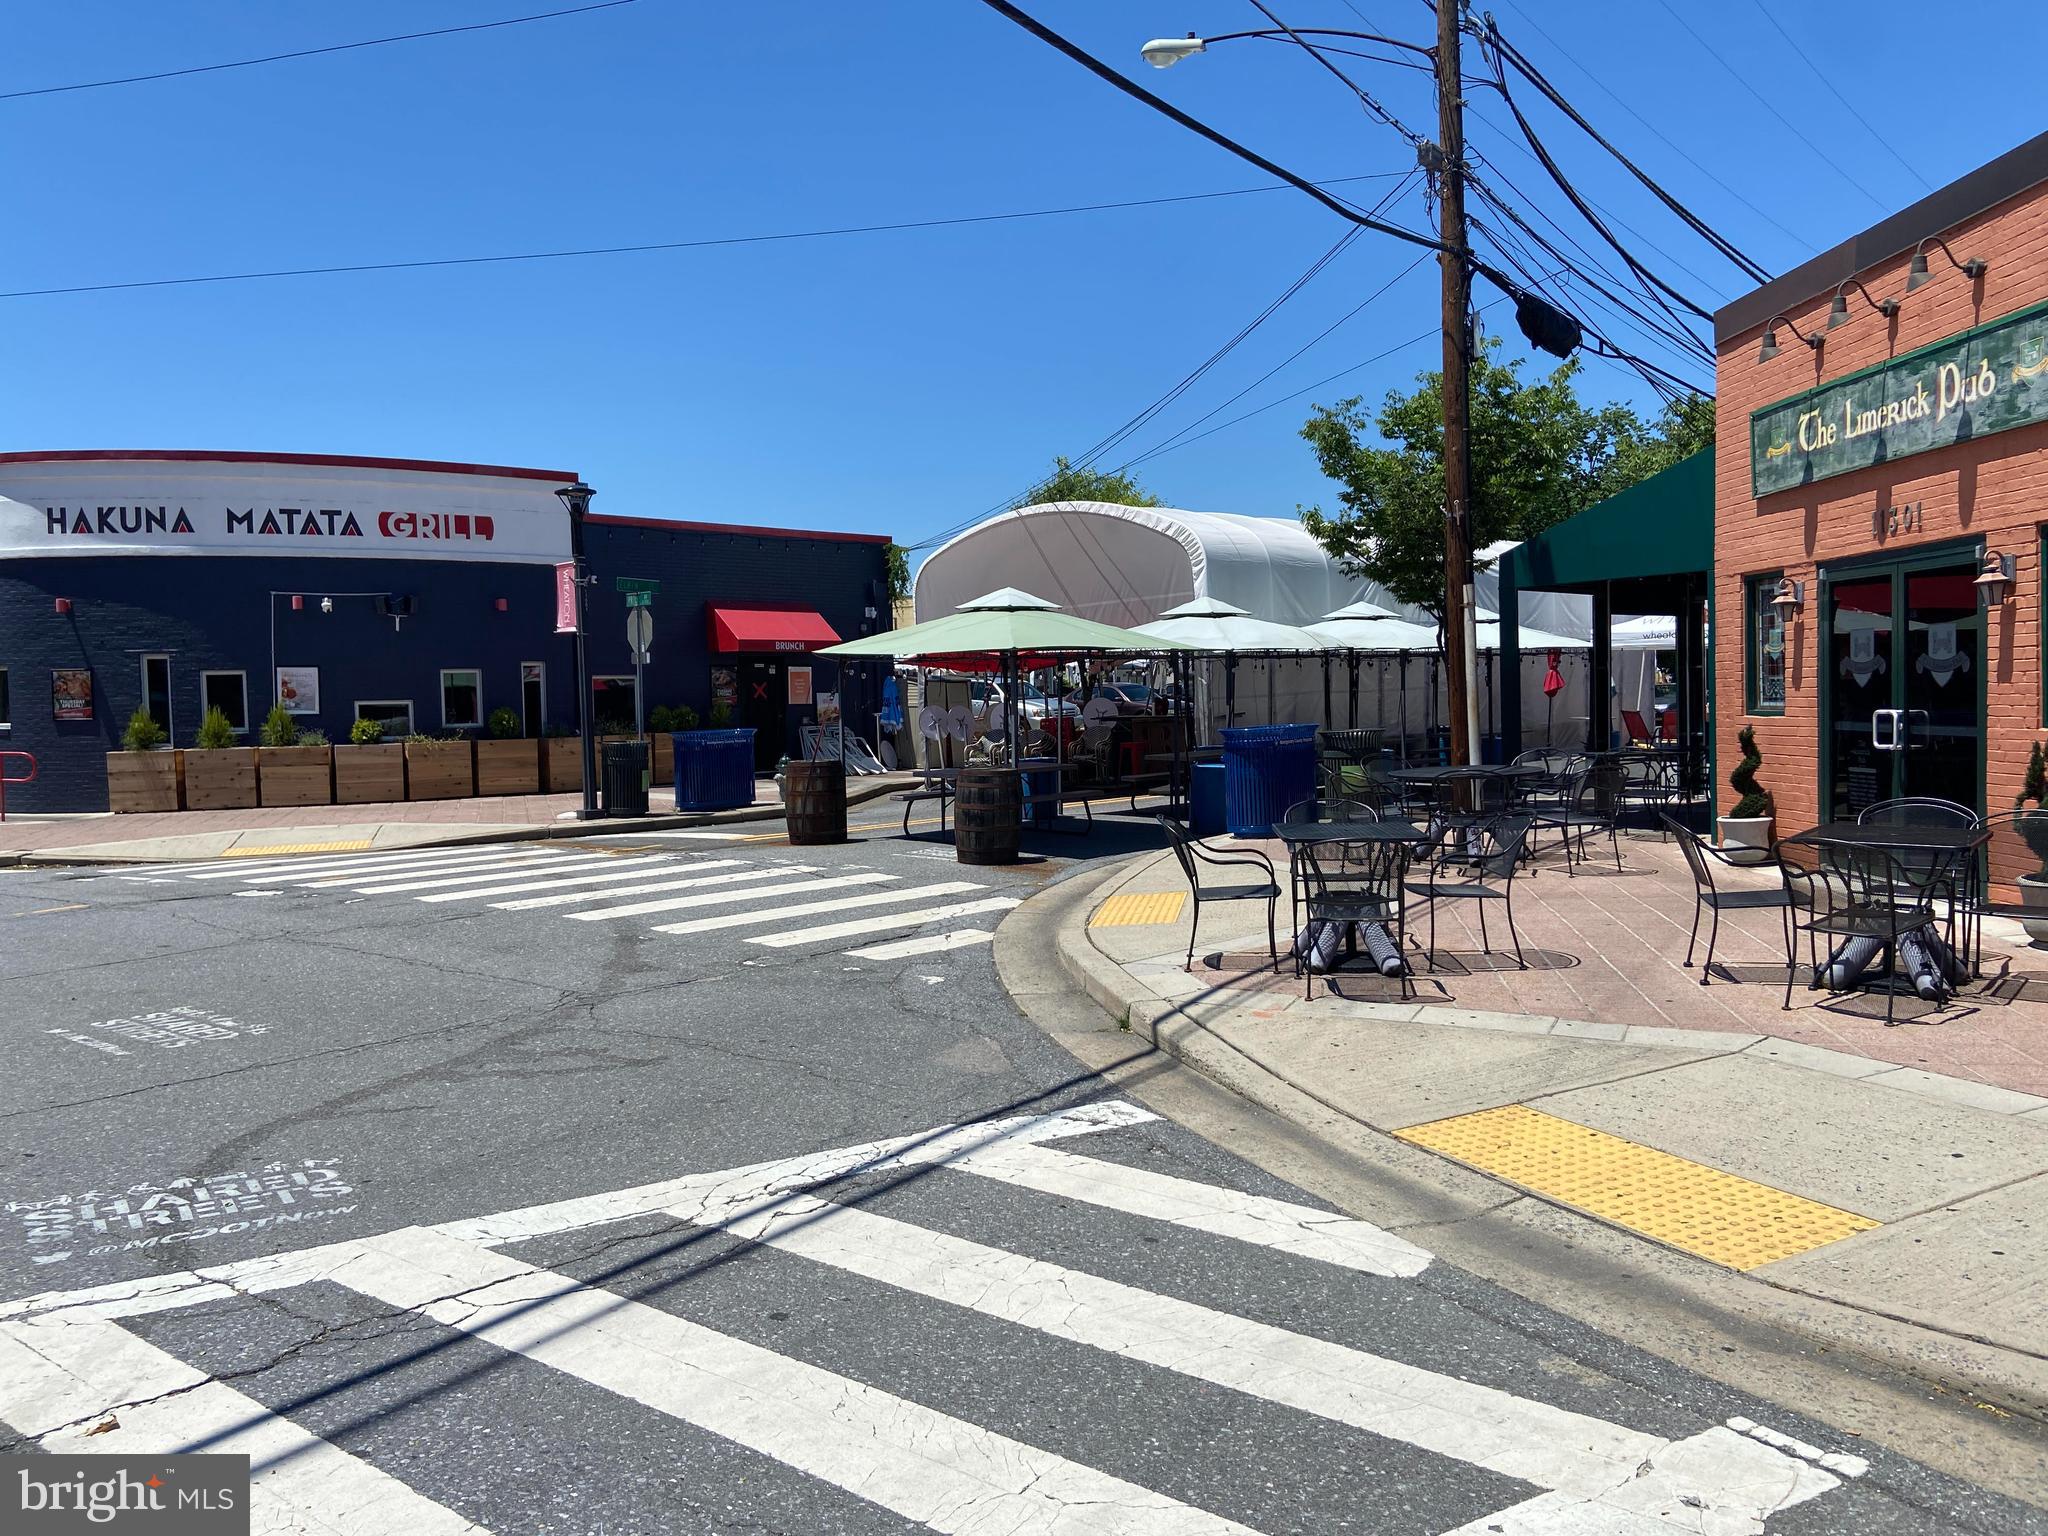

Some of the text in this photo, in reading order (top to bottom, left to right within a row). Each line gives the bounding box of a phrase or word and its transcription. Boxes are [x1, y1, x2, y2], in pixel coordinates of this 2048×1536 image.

[1797, 408, 1837, 452] The
[1937, 358, 1996, 422] Pub
[47, 505, 493, 541] HAKUNA MATATA GRILL
[562, 569, 571, 623] WHEATON
[775, 641, 805, 651] BRUNCH
[23, 1169, 340, 1226] SHARED
[26, 1181, 354, 1244] STREETS
